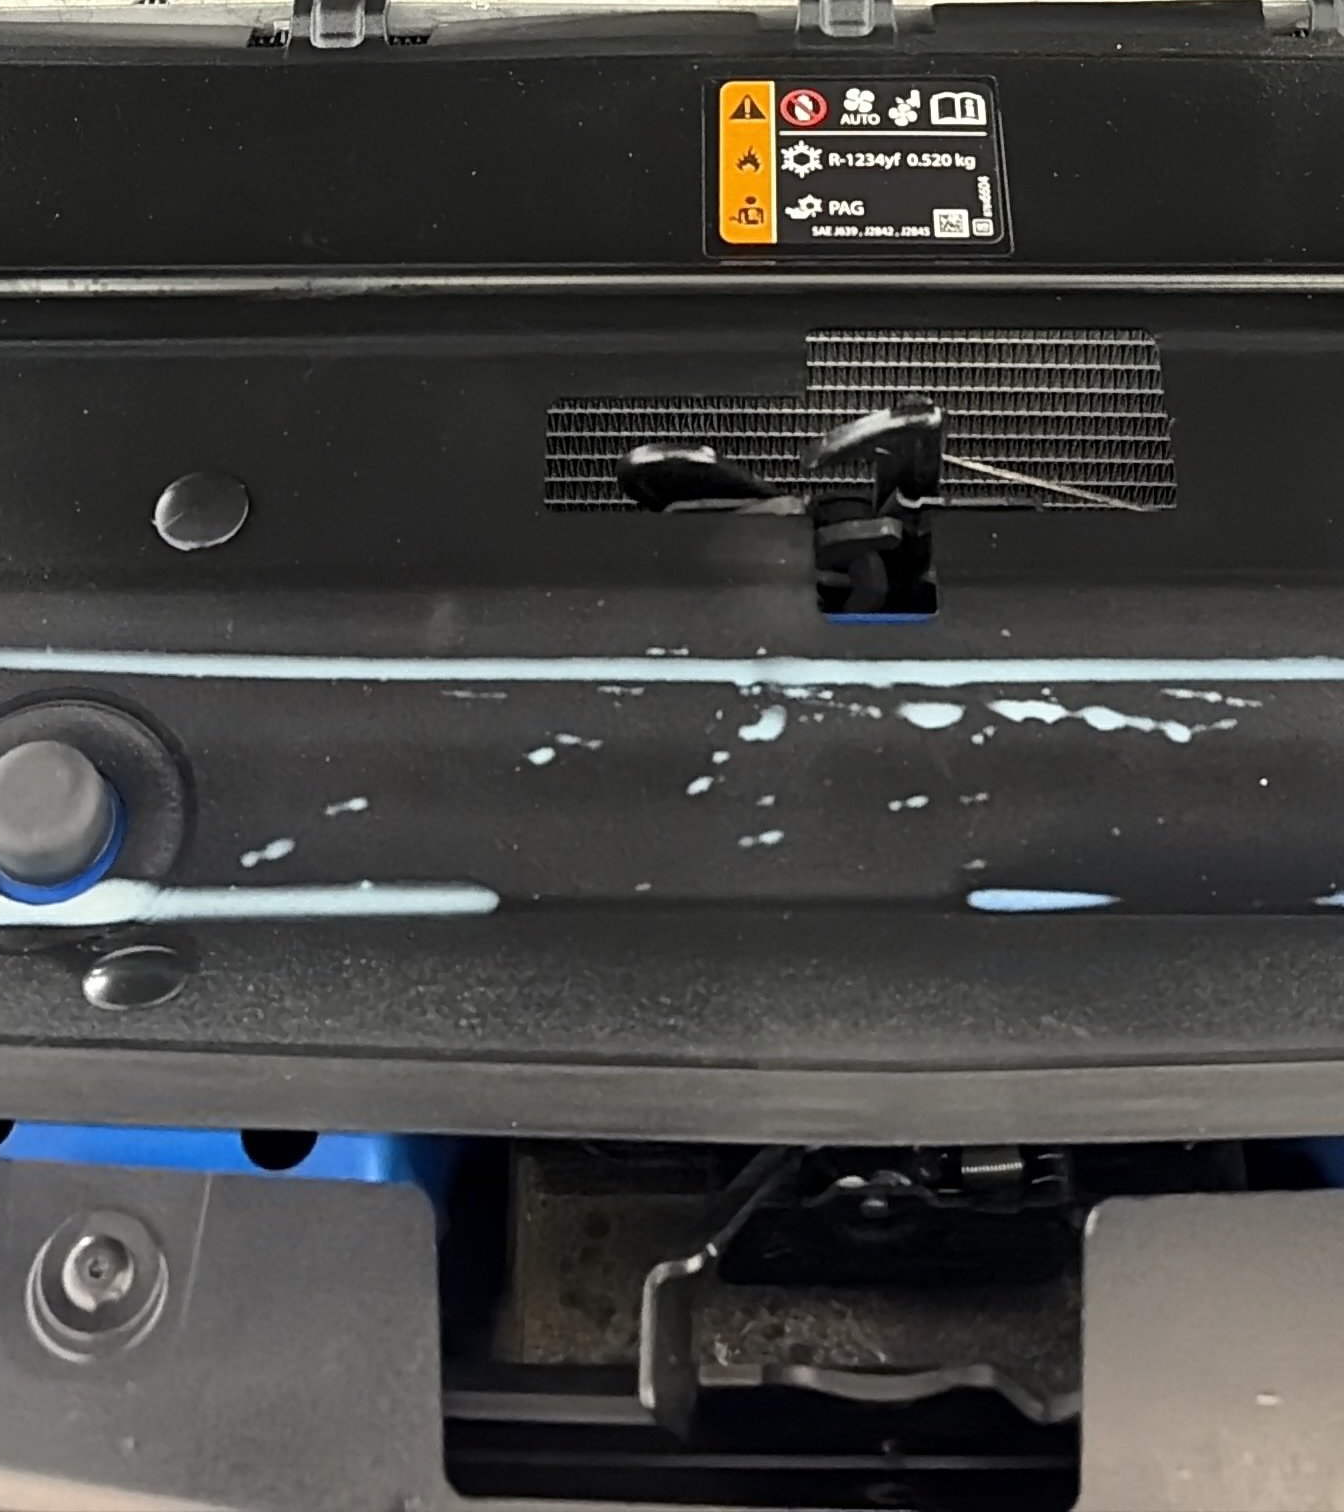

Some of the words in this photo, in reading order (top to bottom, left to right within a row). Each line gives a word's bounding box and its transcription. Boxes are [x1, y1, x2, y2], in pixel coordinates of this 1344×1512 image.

[840, 112, 881, 126] AUTO
[828, 152, 901, 168] R-1234yf
[906, 152, 952, 167] 0.520
[955, 152, 976, 170] kg
[828, 200, 865, 216] PAG
[811, 225, 832, 237] SAE
